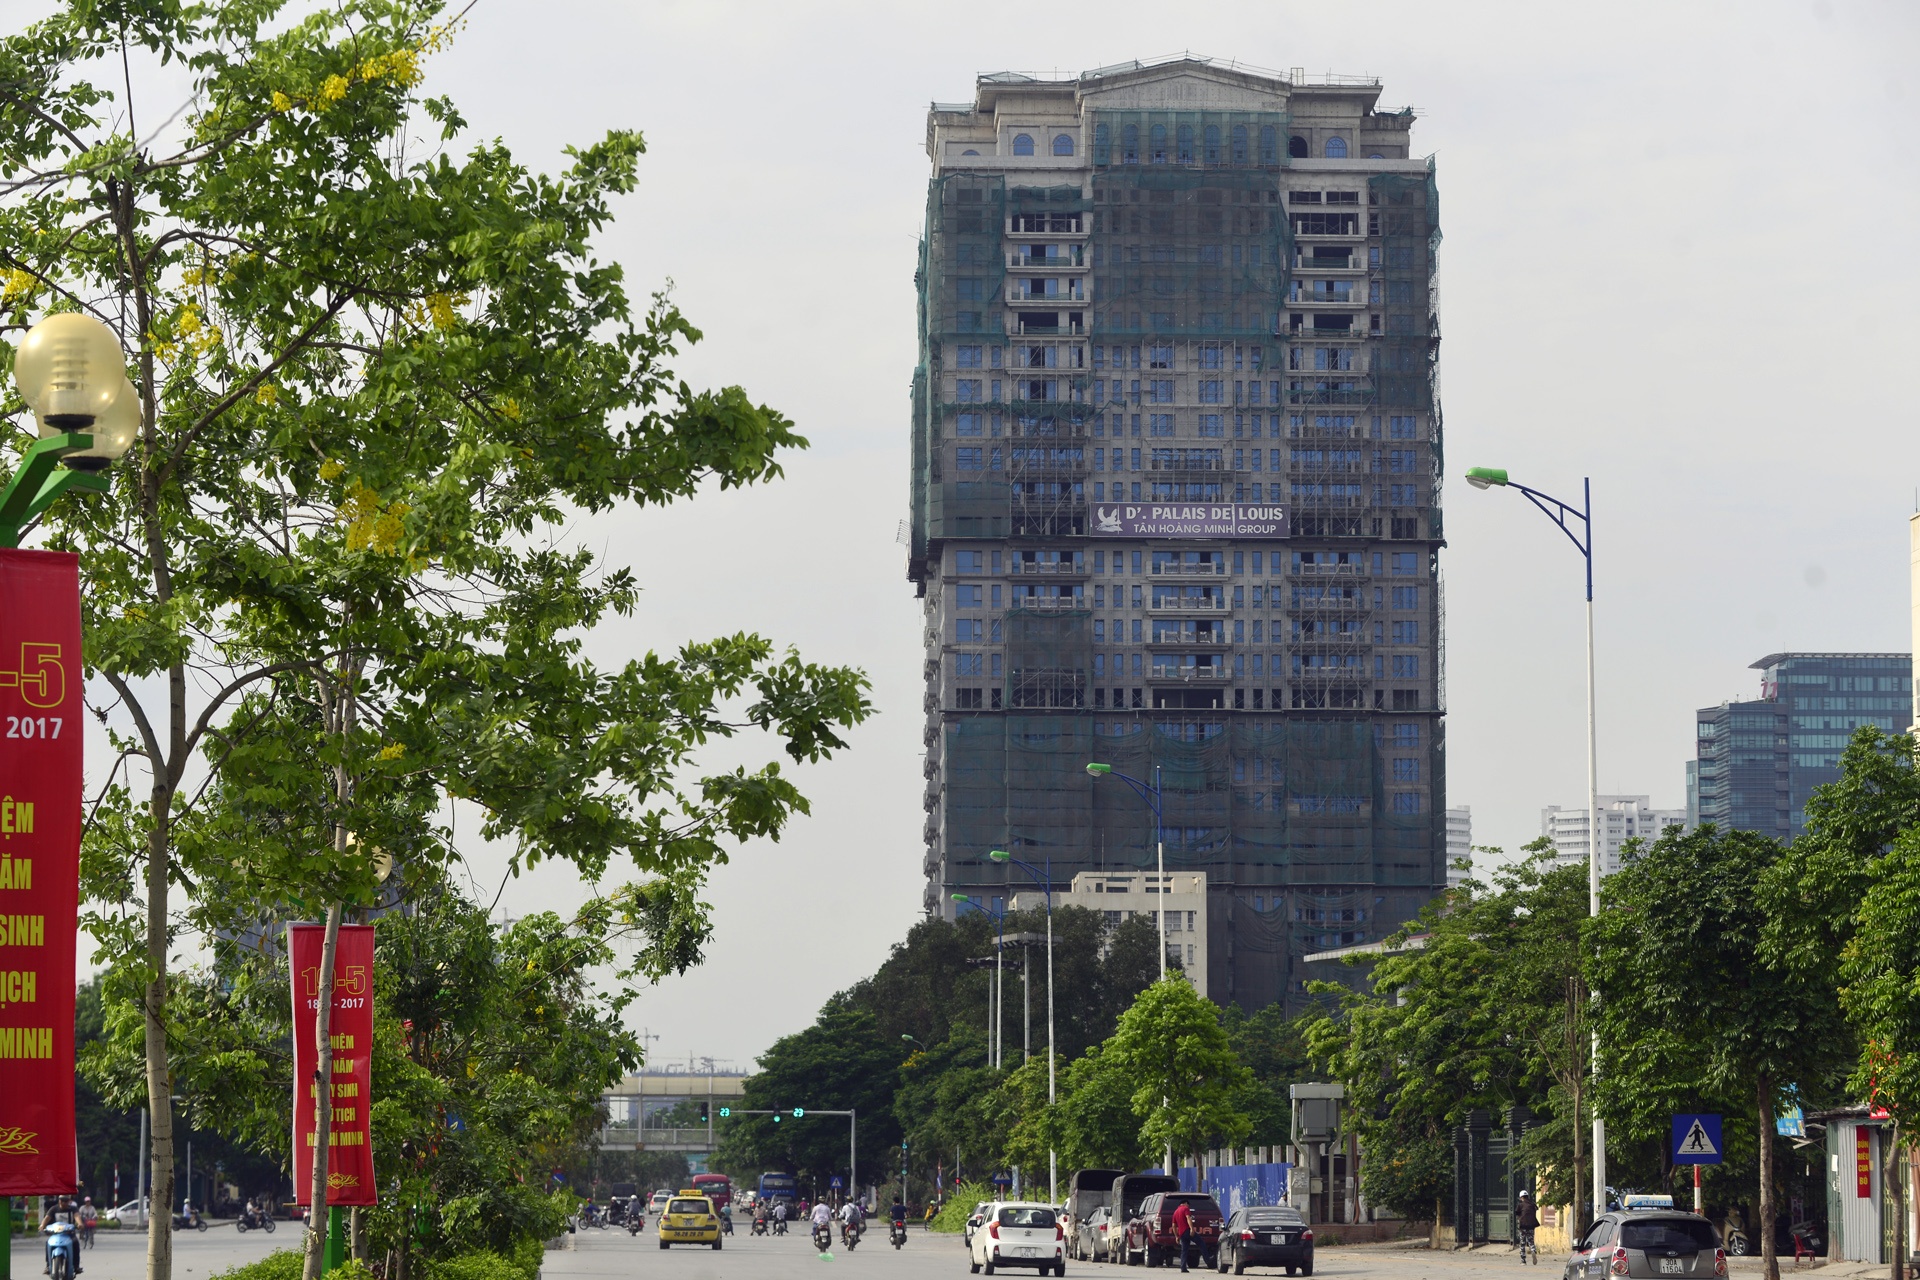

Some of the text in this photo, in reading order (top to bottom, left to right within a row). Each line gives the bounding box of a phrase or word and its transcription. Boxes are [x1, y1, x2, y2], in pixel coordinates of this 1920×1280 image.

[1152, 507, 1206, 520] PALAIS
[1211, 507, 1231, 520] DE
[1238, 507, 1284, 521] LOUIS
[1134, 522, 1277, 534] TÂN HOÀNG MINH GROUP
[6, 716, 63, 739] 2017
[340, 998, 364, 1008] 2017
[0, 1028, 53, 1059] MINH
[333, 1058, 354, 1073] NĂM
[337, 1083, 358, 1098] SINH
[335, 1108, 356, 1125] TỊCH
[720, 1107, 730, 1117] 23
[793, 1107, 804, 1118] 23
[340, 1131, 364, 1146] MINH
